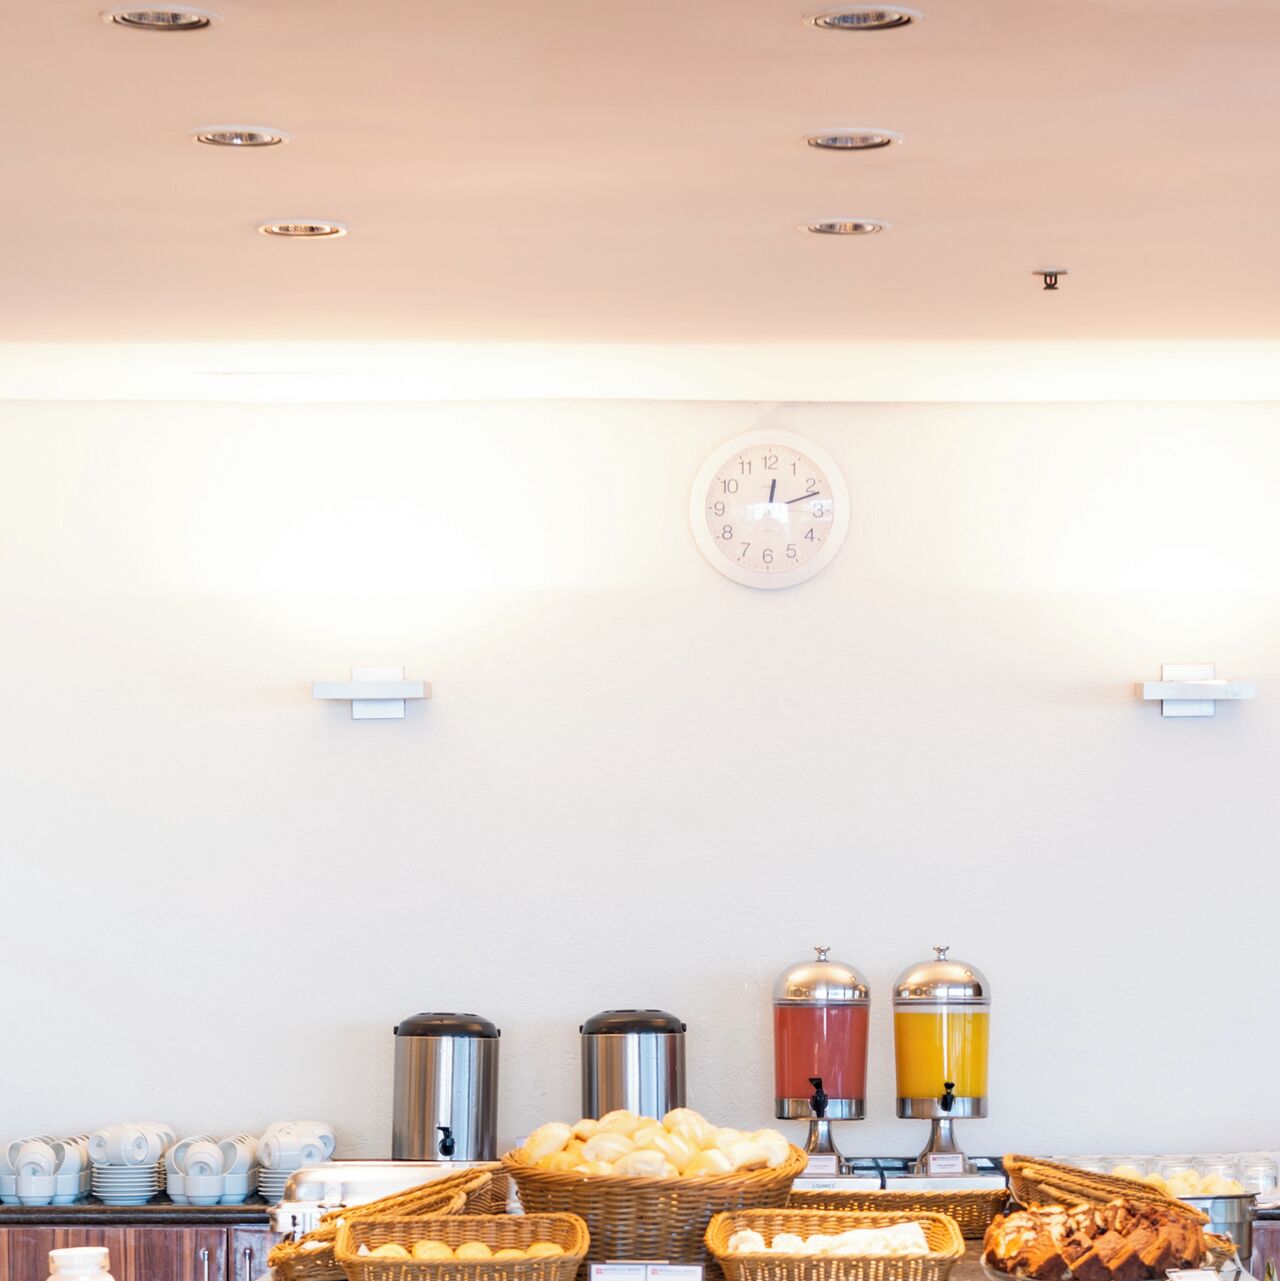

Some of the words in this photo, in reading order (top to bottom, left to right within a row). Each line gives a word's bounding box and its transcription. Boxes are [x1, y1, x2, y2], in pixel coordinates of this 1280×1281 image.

[739, 460, 752, 475] 11
[762, 455, 779, 471] 12
[790, 462, 796, 476] 1
[721, 478, 739, 494] 10
[805, 478, 816, 493] 2
[714, 501, 725, 517] 9
[812, 503, 824, 518] 3
[721, 525, 733, 540] 8
[804, 528, 815, 542] 4
[740, 542, 751, 557] 7
[762, 548, 773, 564] 6
[786, 543, 797, 559] 5
